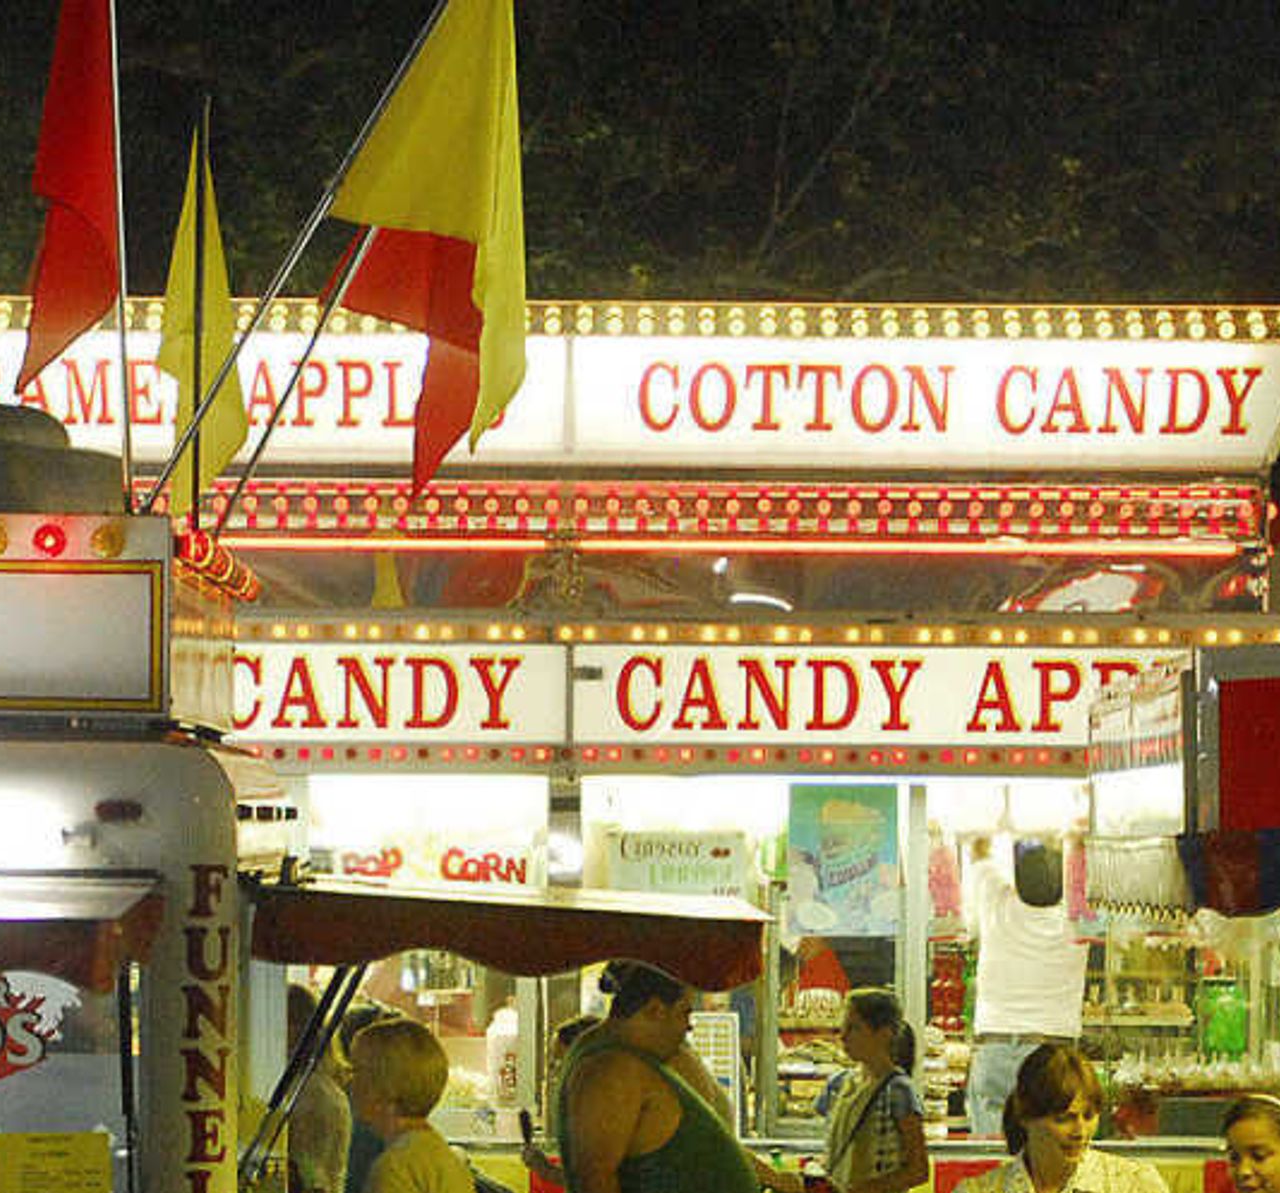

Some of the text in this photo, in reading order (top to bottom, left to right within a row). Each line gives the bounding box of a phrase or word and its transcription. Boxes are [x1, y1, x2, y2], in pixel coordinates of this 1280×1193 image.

[247, 358, 505, 430] APPL
[637, 362, 1264, 435] COTTON CANDY
[232, 655, 523, 731] CANDY
[615, 656, 923, 733] CANDY
